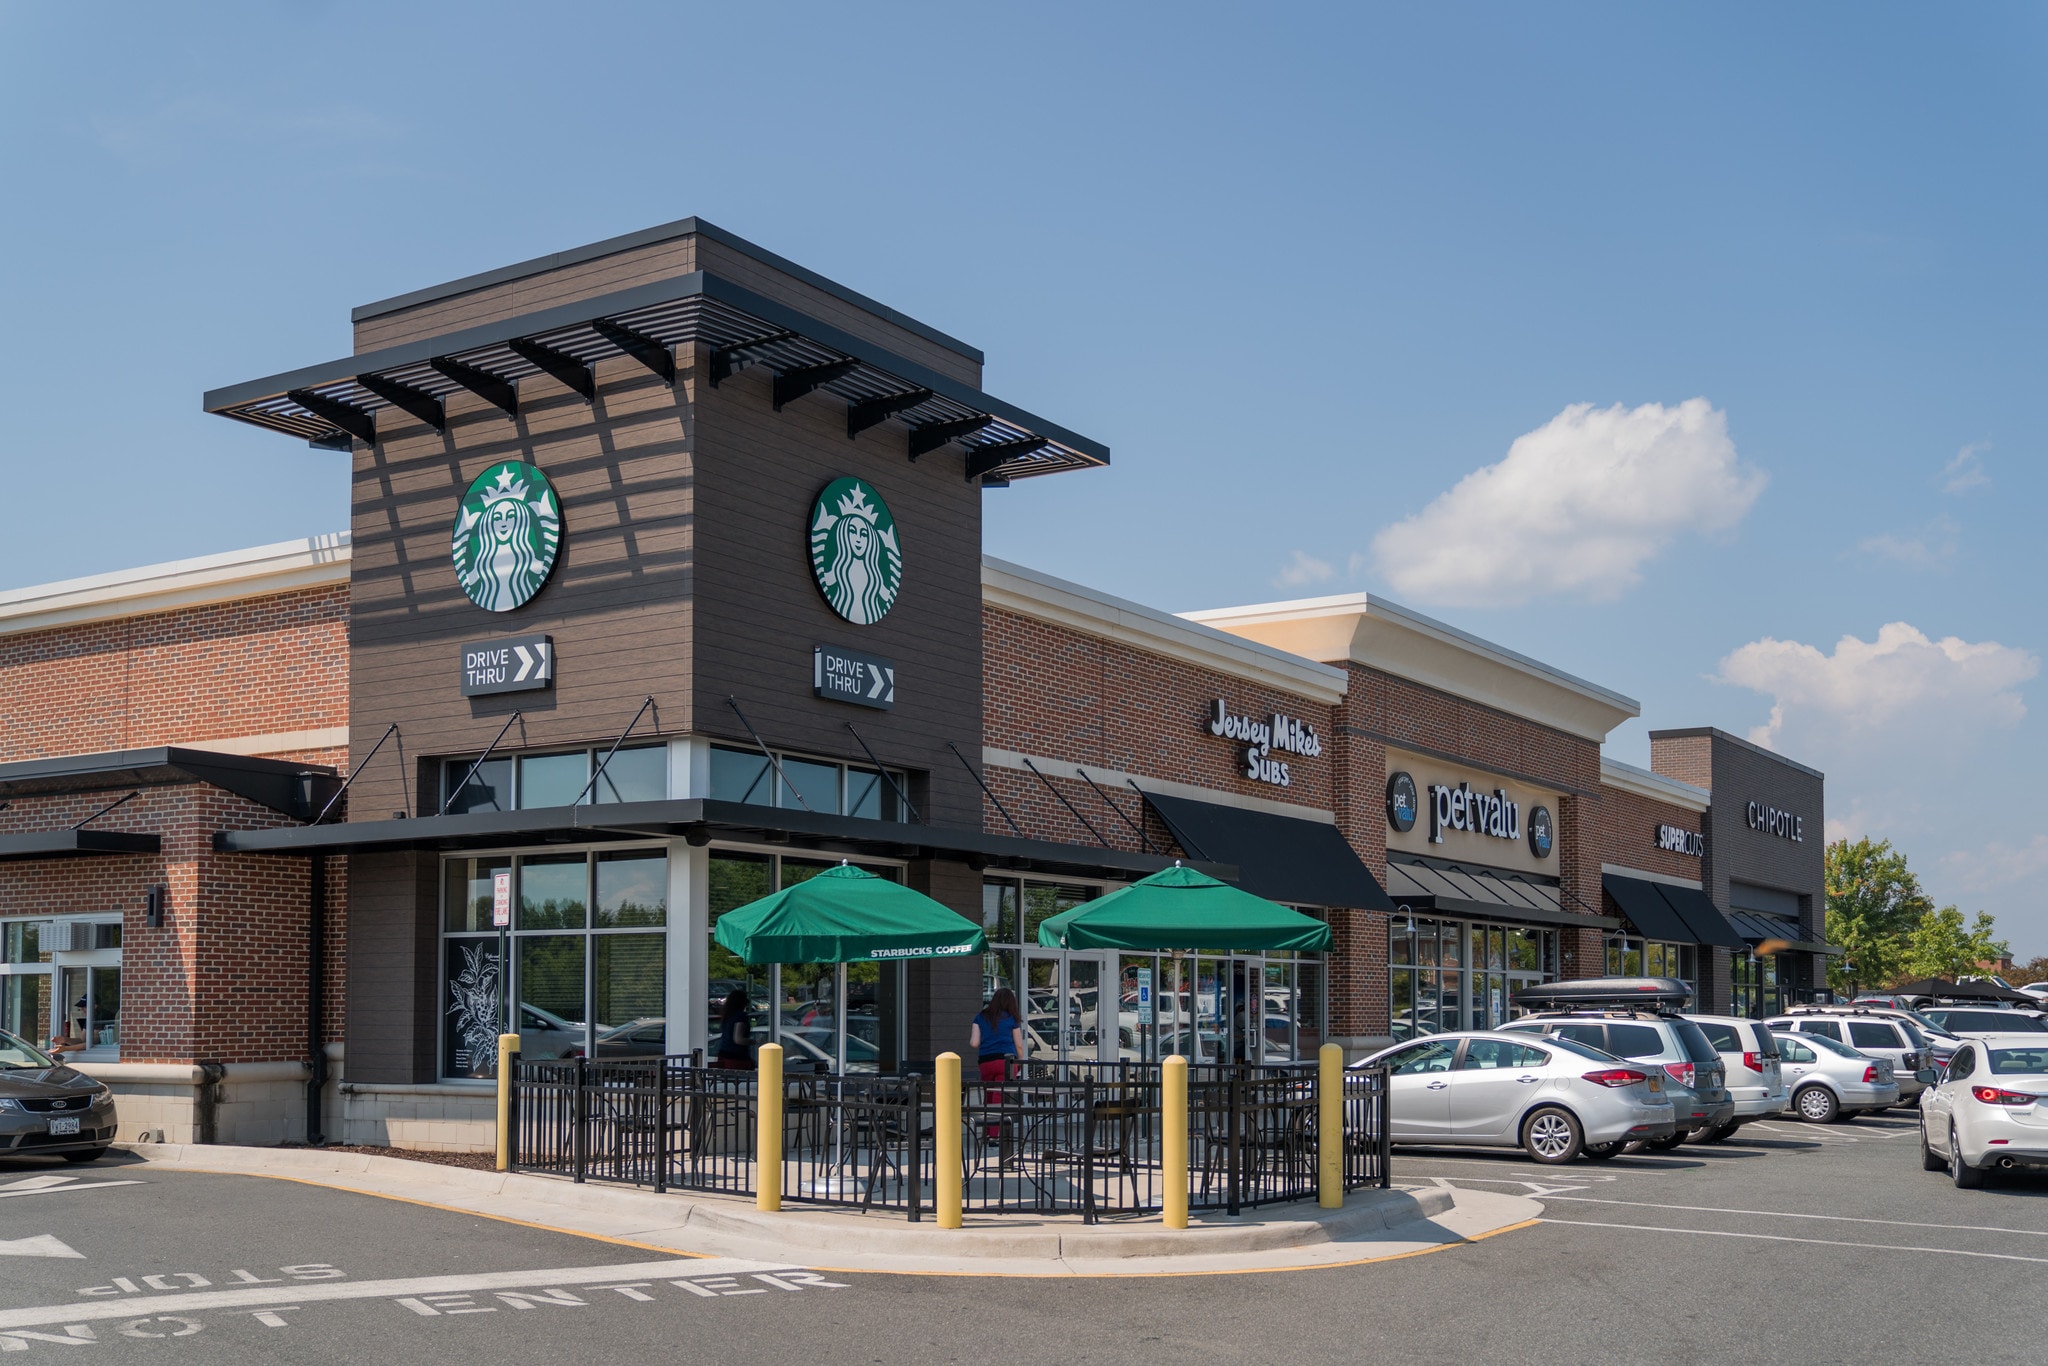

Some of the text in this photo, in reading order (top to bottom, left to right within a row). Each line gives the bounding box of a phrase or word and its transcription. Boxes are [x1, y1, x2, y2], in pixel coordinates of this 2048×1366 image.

[466, 648, 509, 669] DRIVE
[826, 655, 864, 678] DRIVE
[467, 666, 506, 686] THRU
[826, 672, 861, 695] THRU
[1211, 699, 1322, 757] Jersey Mike's
[1394, 793, 1406, 811] pet
[1535, 824, 1546, 840] pet
[1748, 800, 1803, 842] CHIPOTLE
[1659, 824, 1704, 858] SUPERCUTS
[870, 943, 973, 958] STARBUCKS COFFEE
[75, 1262, 348, 1296] STOP
[0, 1270, 852, 1352] NOT ENTER
